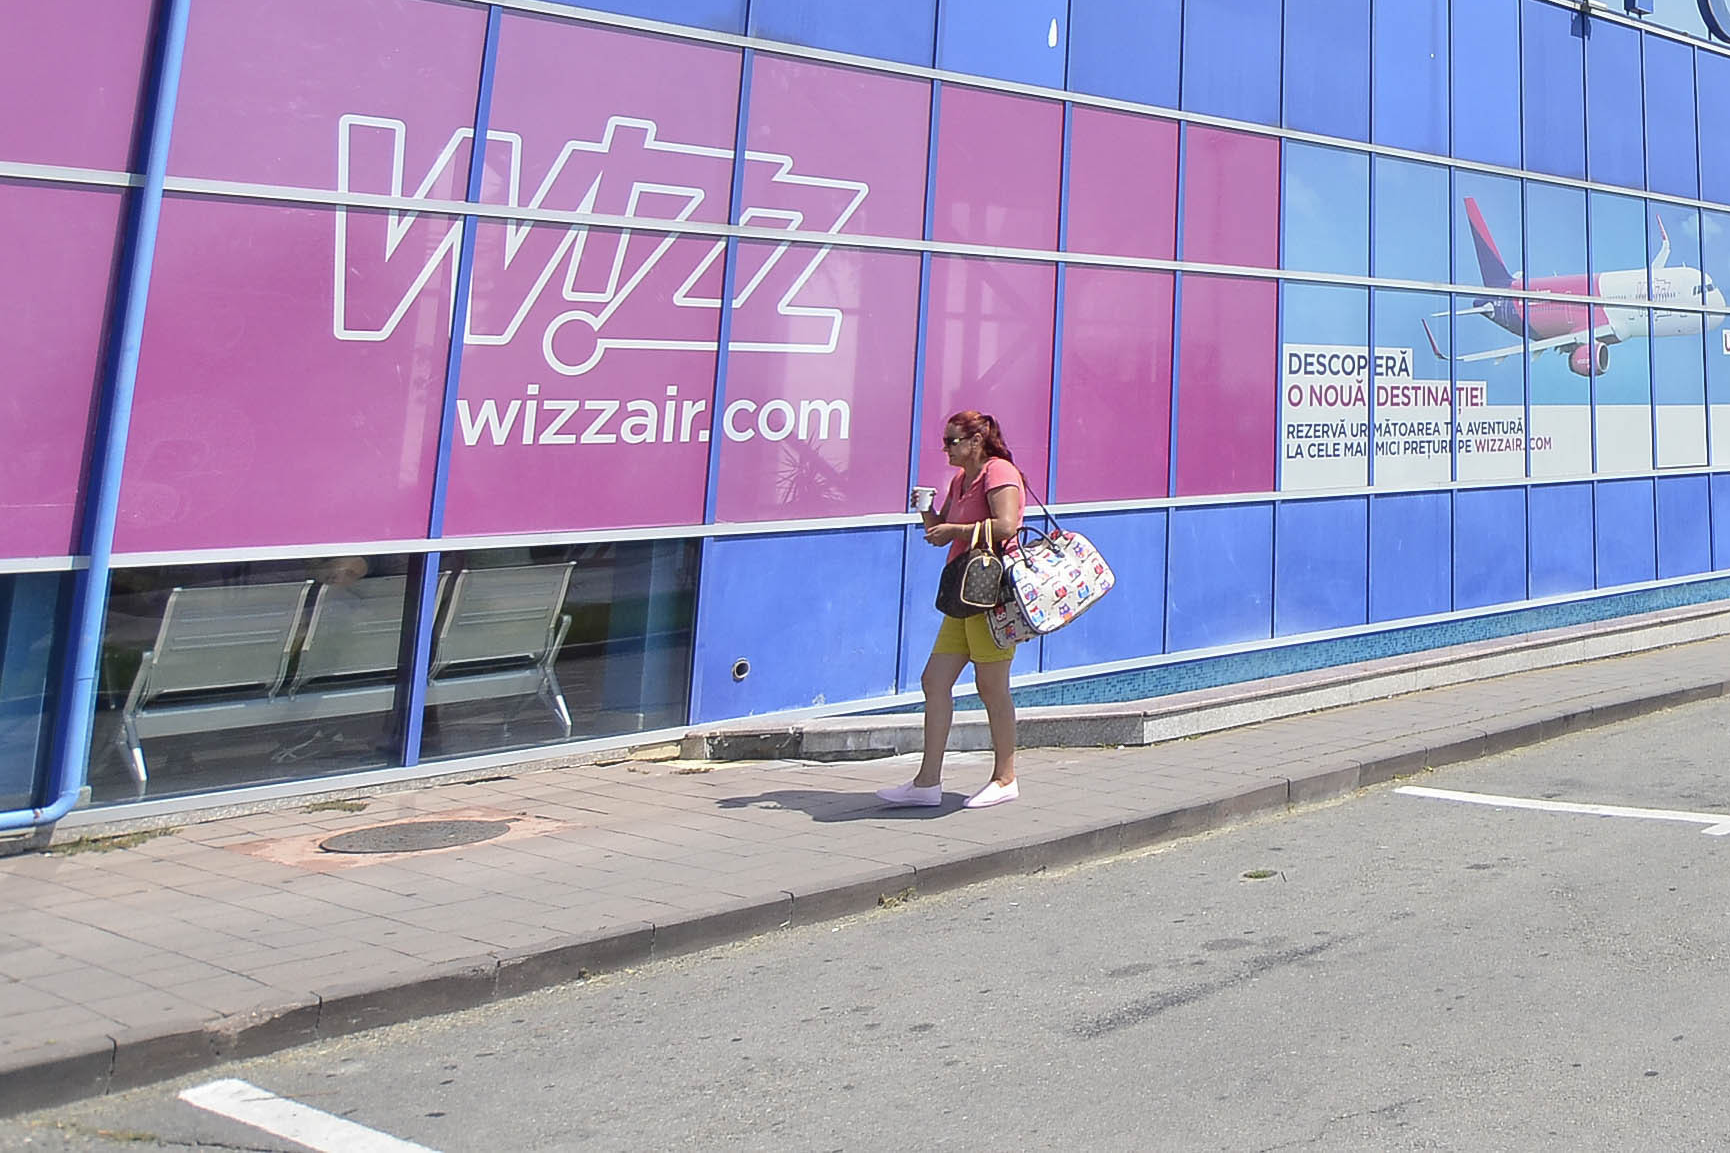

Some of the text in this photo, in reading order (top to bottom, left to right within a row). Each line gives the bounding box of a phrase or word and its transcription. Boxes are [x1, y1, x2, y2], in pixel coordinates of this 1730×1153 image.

[1288, 350, 1410, 377] DESCOPERĂ
[1288, 384, 1303, 407] O
[1309, 379, 1366, 407] NOUĂ
[456, 384, 850, 445] wizzair.com
[1287, 419, 1347, 439] REZERVĂ
[1444, 422, 1463, 436] TA
[1466, 417, 1523, 435] AVENTURĂ
[1286, 444, 1304, 459] LA
[1307, 443, 1341, 458] CELE
[1344, 442, 1367, 457] MAI
[1375, 441, 1400, 456] MICI
[1458, 440, 1472, 453] PE
[1475, 437, 1552, 453] WIZZAIR.COM
